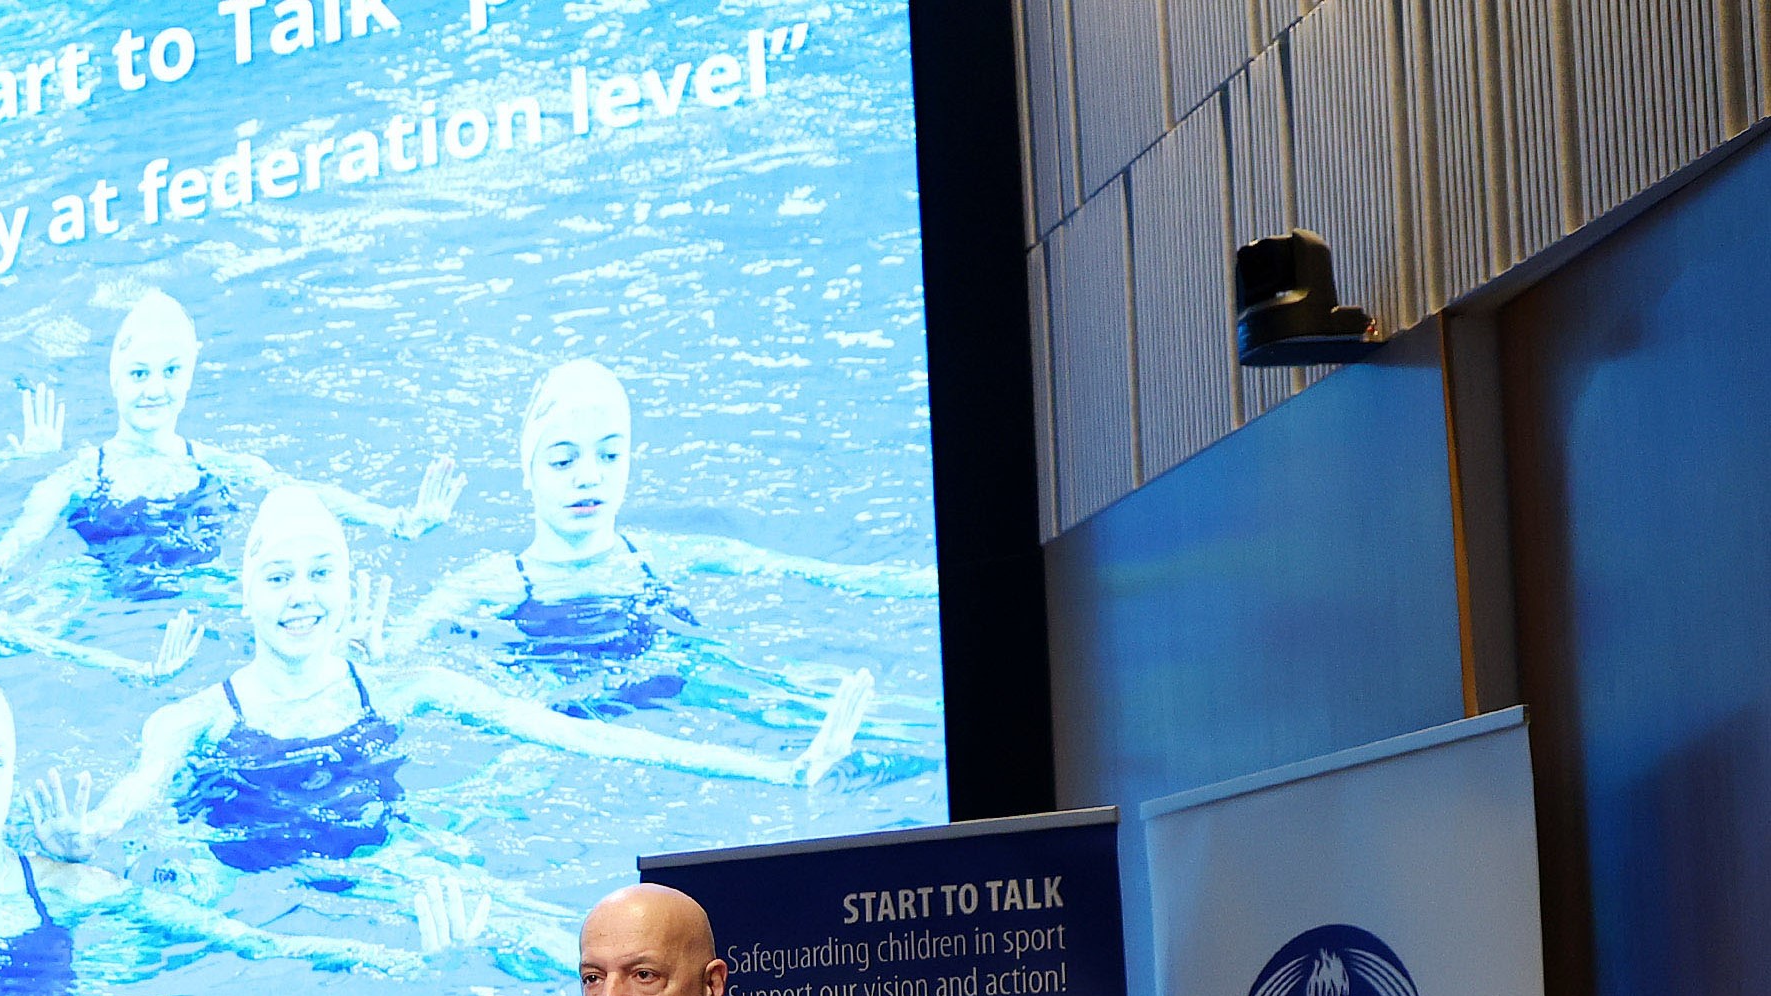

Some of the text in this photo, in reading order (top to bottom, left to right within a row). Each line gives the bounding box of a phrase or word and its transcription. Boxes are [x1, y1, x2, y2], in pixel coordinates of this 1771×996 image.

[113, 26, 197, 90] to
[48, 177, 122, 245] at
[137, 92, 543, 225] federation
[570, 23, 809, 135] level”
[842, 875, 1064, 925] START TO TALK
[727, 923, 1066, 979] Safeguarding children in sport
[985, 962, 1068, 996] action!
